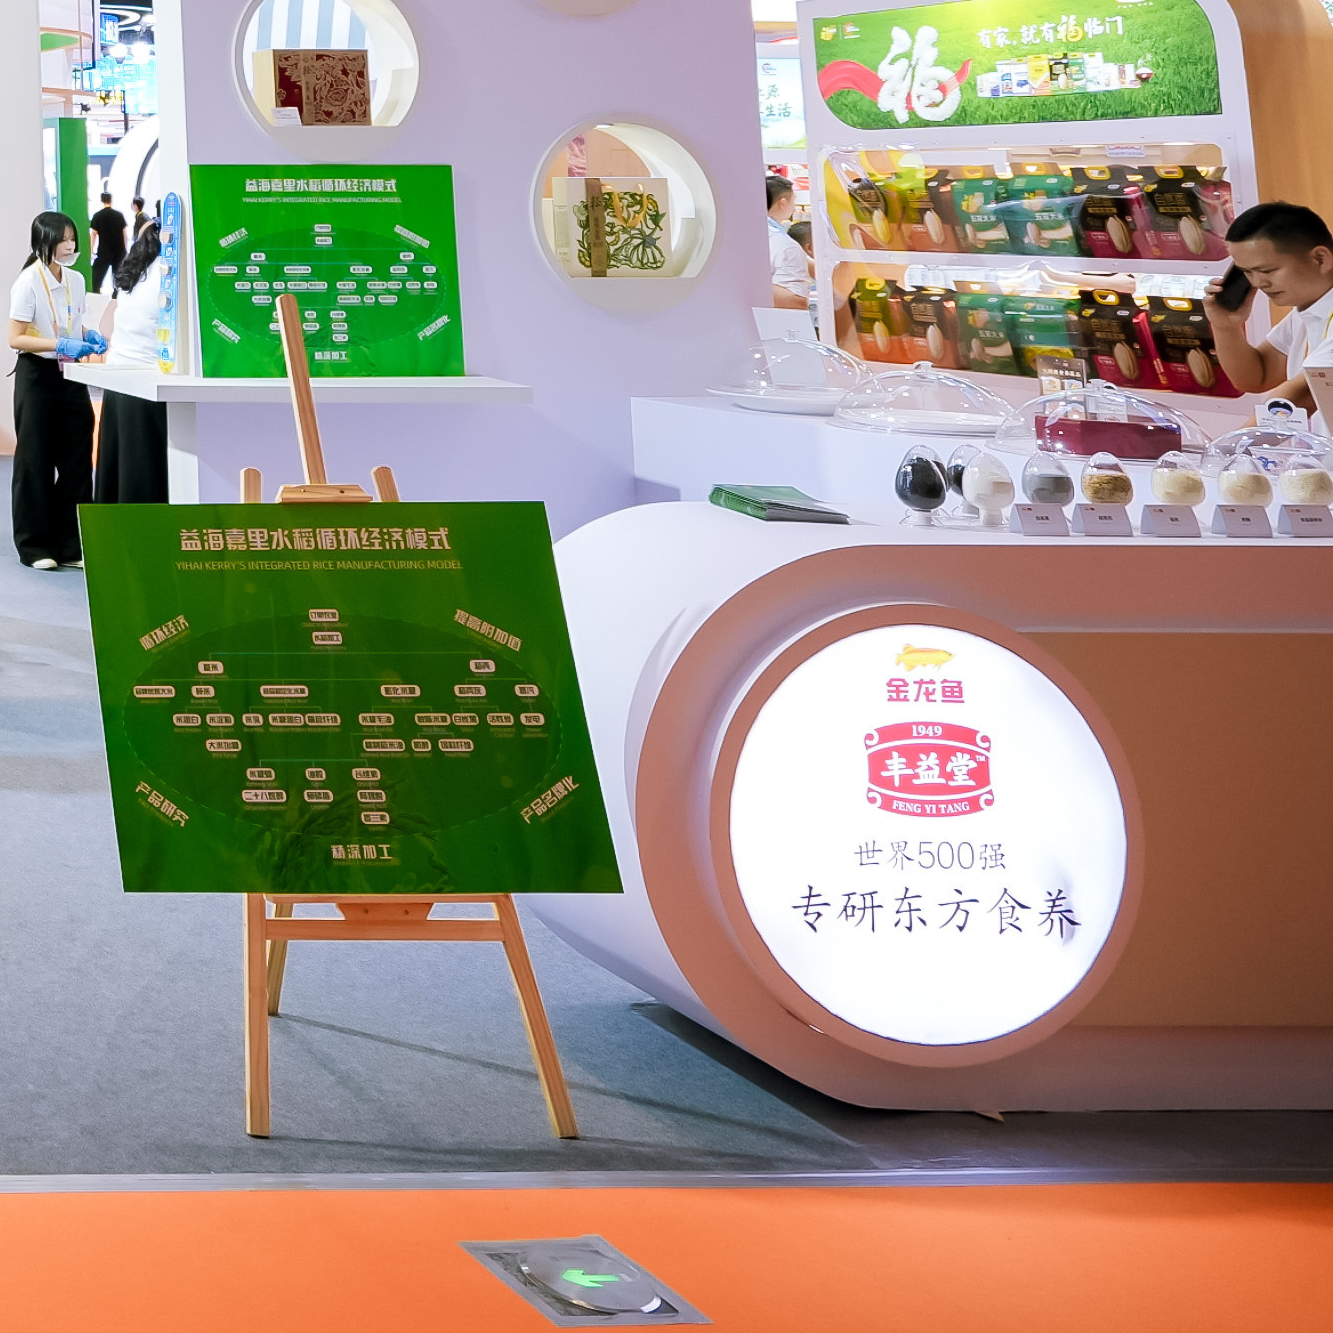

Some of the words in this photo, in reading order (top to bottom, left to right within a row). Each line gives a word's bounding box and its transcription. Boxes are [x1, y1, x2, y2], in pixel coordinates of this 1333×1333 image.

[759, 102, 791, 118] 生活
[180, 527, 451, 550] 益海嘉里水稻循环经济模式
[247, 560, 311, 571] INTEGRATED
[312, 560, 334, 571] RICE
[336, 560, 425, 571] MANUFACTURING
[426, 560, 462, 571] MODEL
[139, 614, 190, 651] 循环经济
[454, 608, 522, 652] 提高附加值
[886, 677, 965, 704] 金龙鱼
[911, 725, 942, 737] 1949
[880, 751, 977, 788] 丰益堂
[135, 780, 190, 827] 产品研究
[892, 800, 921, 813] FENG
[923, 803, 938, 814] YI
[938, 800, 970, 814] TANG
[330, 844, 393, 860] 精深加工
[853, 840, 1006, 870] 世界500强
[791, 884, 1082, 939] 专研东方食养
